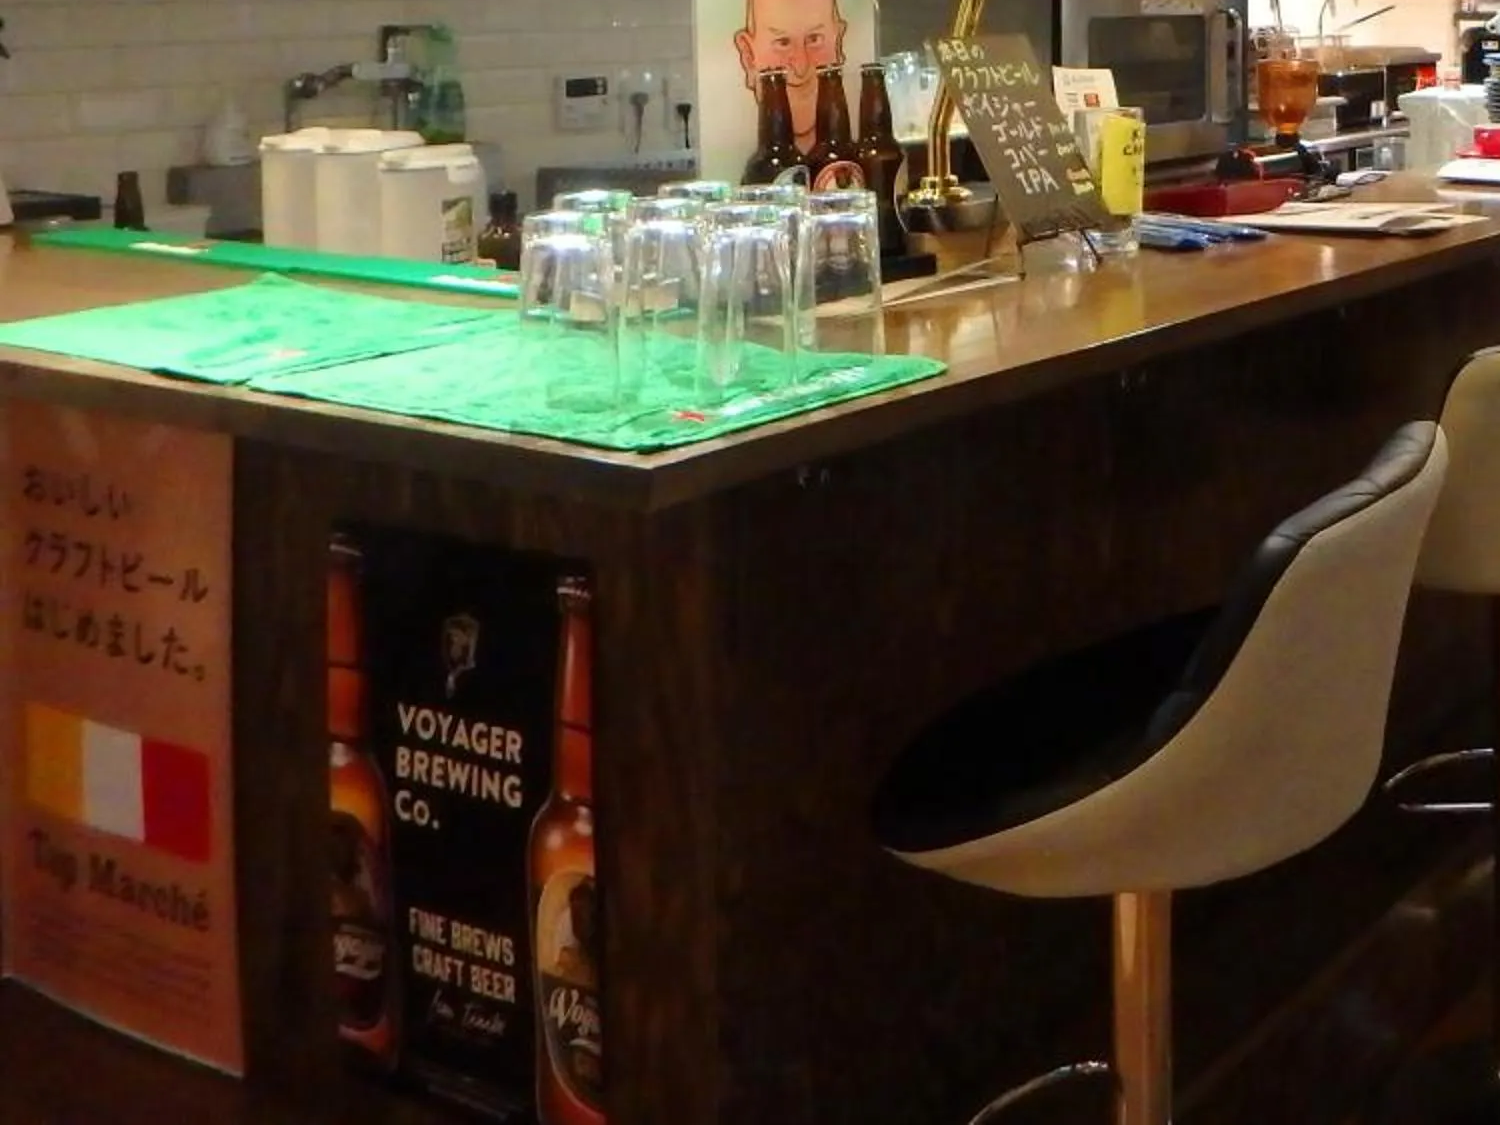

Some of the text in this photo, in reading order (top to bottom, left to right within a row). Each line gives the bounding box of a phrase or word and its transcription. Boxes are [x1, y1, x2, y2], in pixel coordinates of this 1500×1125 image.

[1016, 167, 1060, 194] IPA
[23, 465, 133, 520] おいしい
[24, 530, 209, 604] クラフトビール
[397, 701, 522, 764] VOYAGER
[395, 746, 522, 809] BREWING
[89, 852, 211, 933] Marché
[409, 906, 516, 966] FINE BREWS
[412, 943, 465, 988] CRAFT
[469, 964, 516, 1004] BEER
